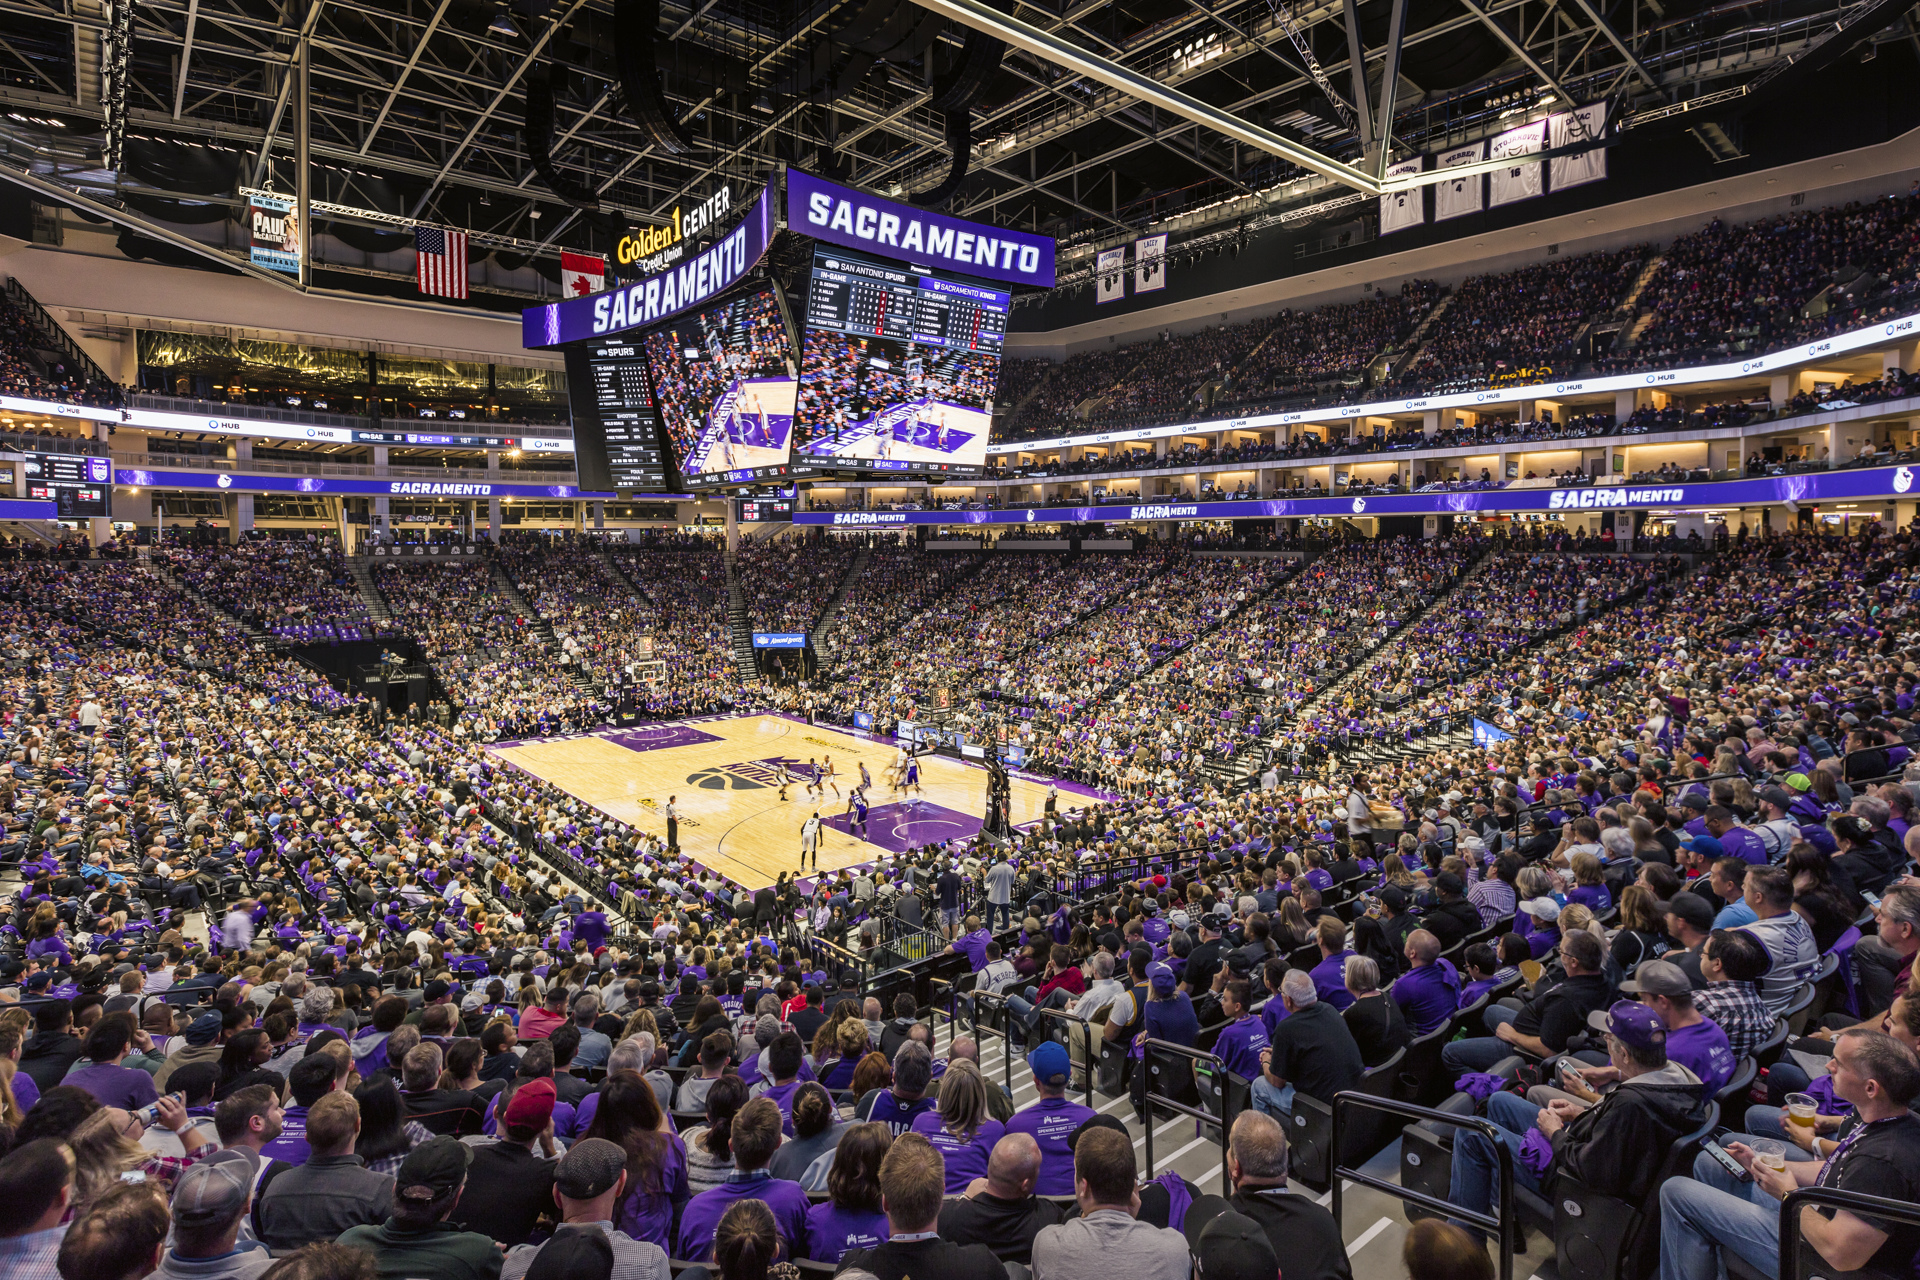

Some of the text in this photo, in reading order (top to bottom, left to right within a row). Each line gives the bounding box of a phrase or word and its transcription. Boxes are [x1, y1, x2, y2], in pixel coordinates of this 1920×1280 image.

[1494, 134, 1540, 152] STOJAKOVIC
[1445, 151, 1475, 164] WEBBER
[1510, 168, 1521, 178] 16
[1455, 184, 1462, 192] 4
[1791, 193, 1805, 206] 207
[682, 186, 730, 238] CENTER
[253, 212, 287, 236] PAUL
[253, 232, 287, 243] McCARTNEY
[808, 191, 1040, 274] SACRAMENTO
[642, 246, 682, 272] Credit Union
[592, 224, 746, 334] SACRAMENTO
[820, 271, 847, 282] IN-GAME
[841, 264, 906, 282] SAN ANTONIO SPURS
[924, 292, 947, 301] IN-GAME
[941, 284, 996, 300] SACRAMENTO KINGS
[1895, 320, 1913, 332] HUB
[608, 348, 634, 356] SPURS
[1817, 343, 1831, 352] HUB
[390, 483, 491, 495] SACRAMENTO
[1549, 488, 1684, 508] SACRAMENTO
[833, 513, 906, 524] SACRAMENTO
[1130, 506, 1197, 519] SACRAMENTO
[1618, 516, 1629, 526] 109
[941, 696, 947, 707] 5
